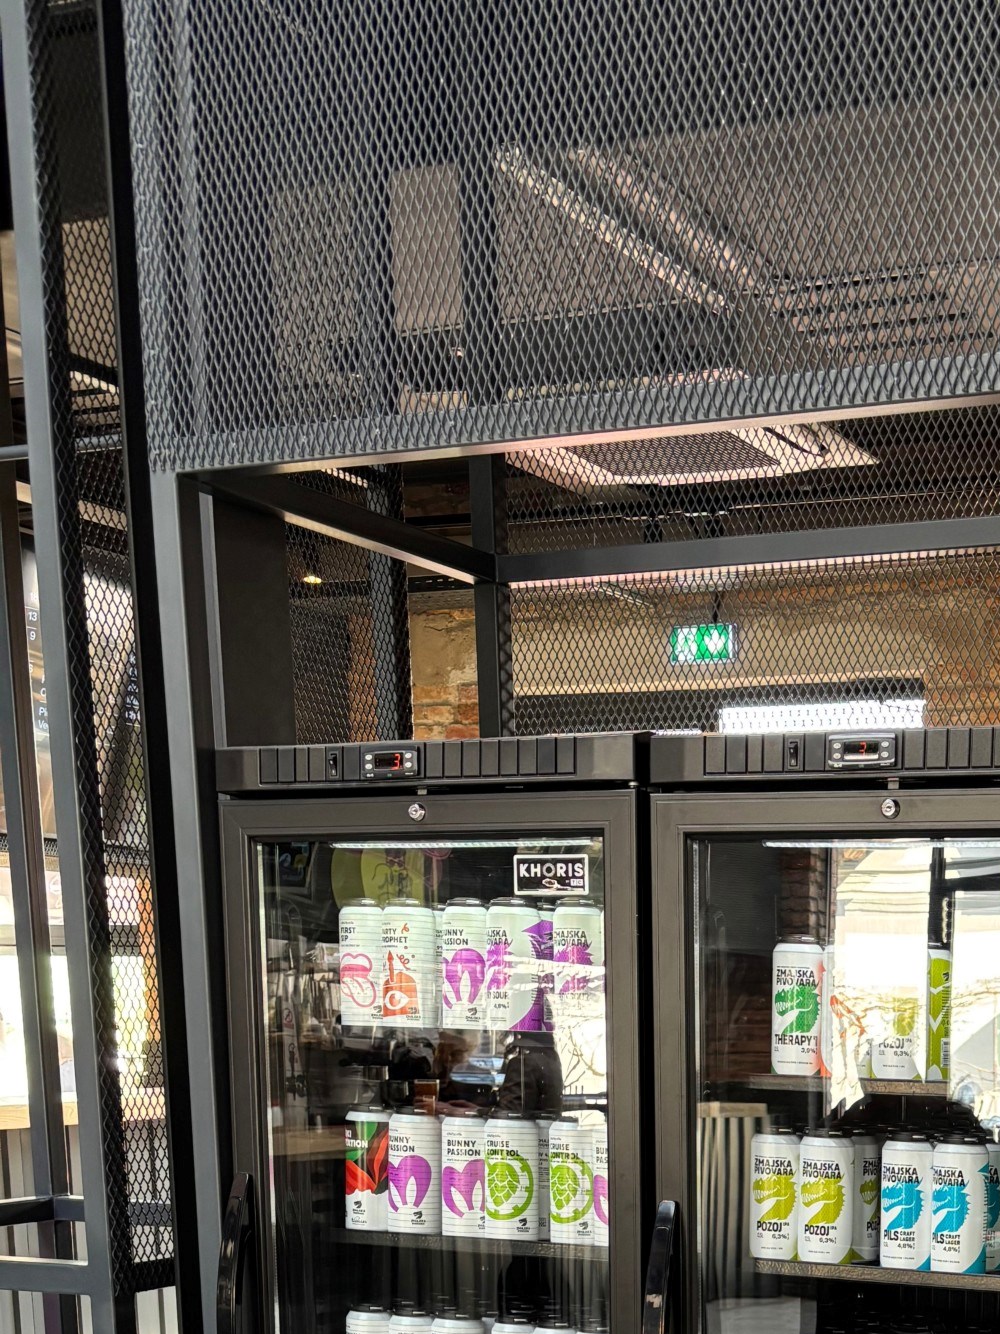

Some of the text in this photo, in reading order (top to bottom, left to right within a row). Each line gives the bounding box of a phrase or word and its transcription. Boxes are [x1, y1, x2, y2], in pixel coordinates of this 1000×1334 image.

[391, 752, 401, 770] 3
[520, 863, 584, 878] KHORIS
[775, 1034, 812, 1046] THERAPY
[447, 1139, 476, 1148] BUNNY
[487, 1140, 510, 1148] CRUISE
[447, 1148, 480, 1156] PASSION
[487, 1149, 520, 1157] CONTROL
[755, 1158, 792, 1167] ZMAJSKA
[802, 1161, 840, 1171] ZMAJSKA
[754, 1167, 794, 1176] PIVOVARA
[802, 1170, 842, 1179] PIVOVARA
[883, 1174, 920, 1184] PIVOVARA
[756, 1221, 782, 1232] POZOJ
[804, 1224, 830, 1236] POZOJ
[884, 1230, 899, 1241] PILS
